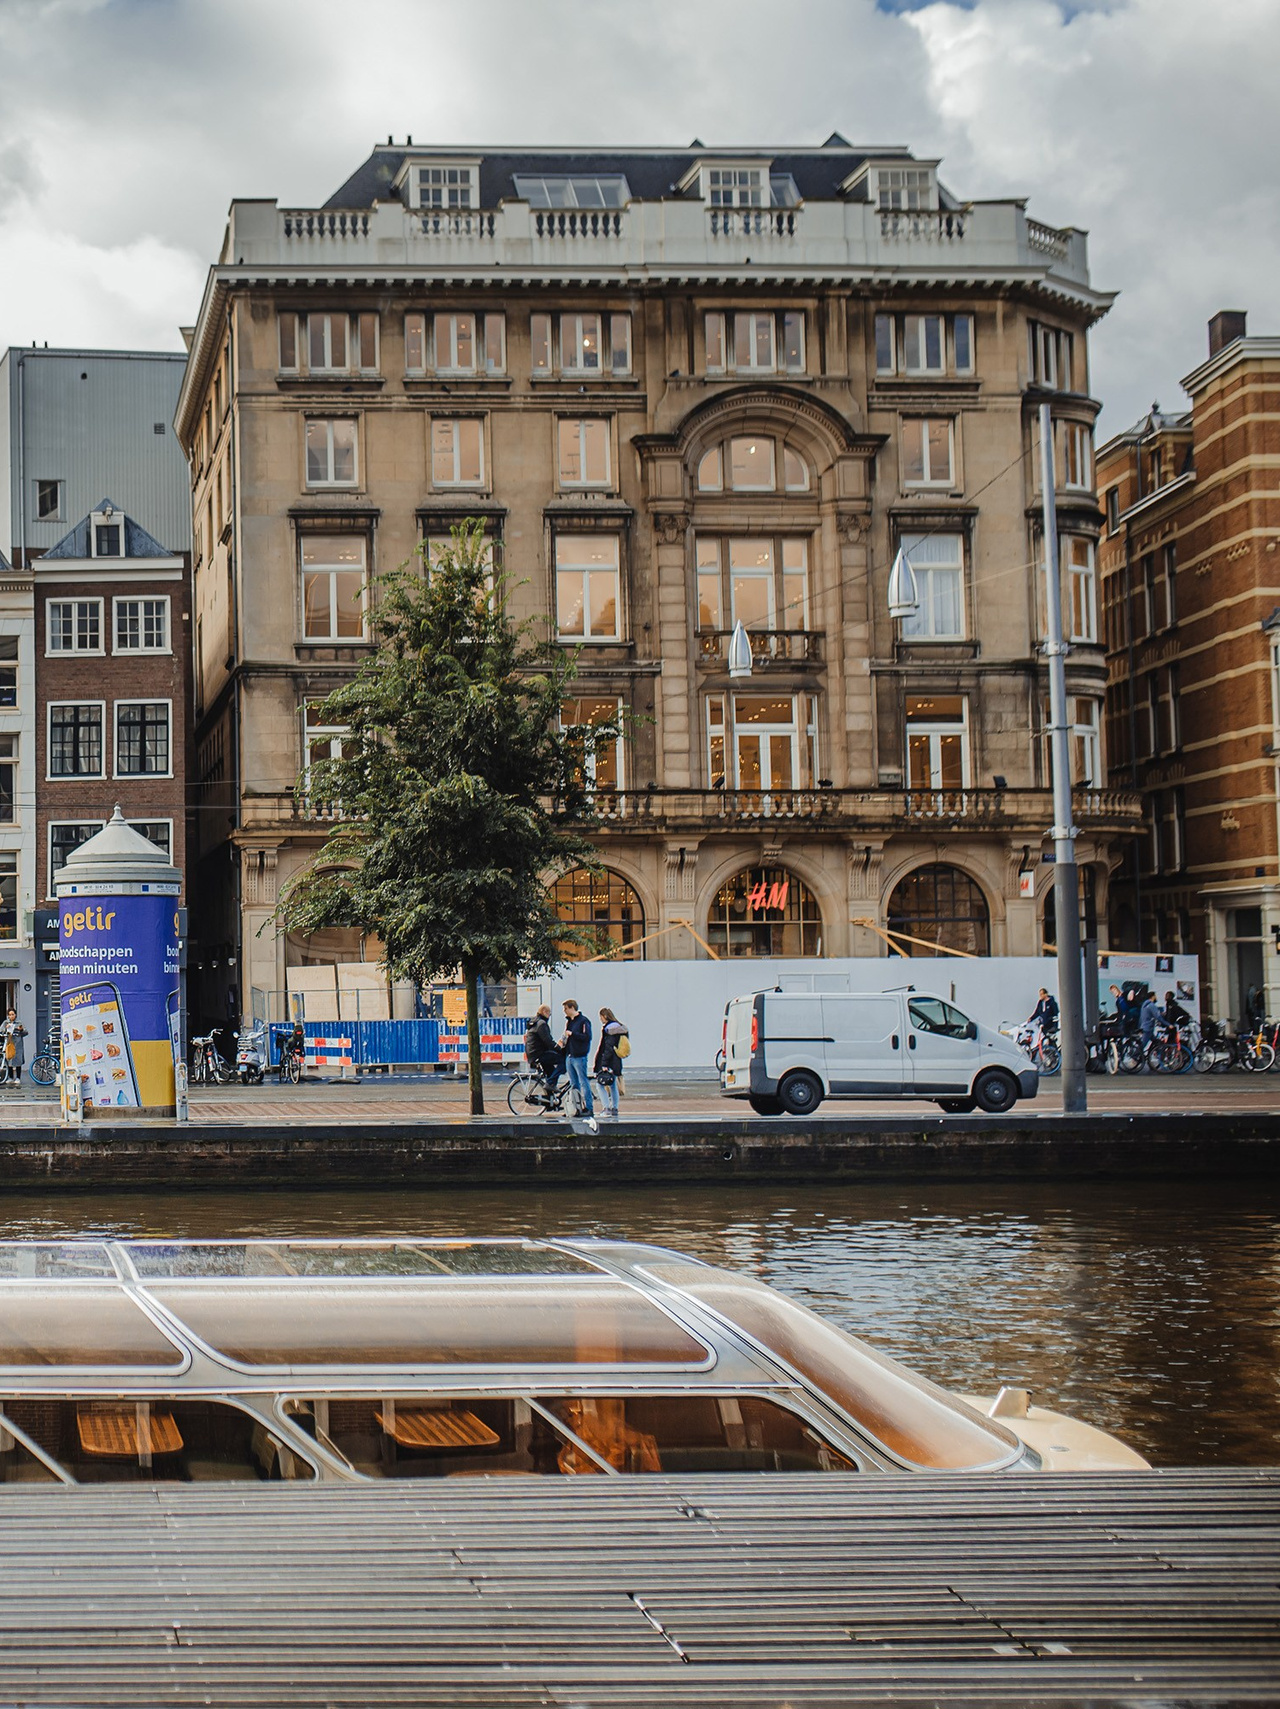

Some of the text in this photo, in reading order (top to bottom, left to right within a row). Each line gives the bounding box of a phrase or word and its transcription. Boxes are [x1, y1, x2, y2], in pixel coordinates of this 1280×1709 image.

[747, 882, 789, 911] H&M
[63, 906, 116, 938] getir
[82, 962, 138, 974] minuten
[69, 992, 93, 1010] getir
